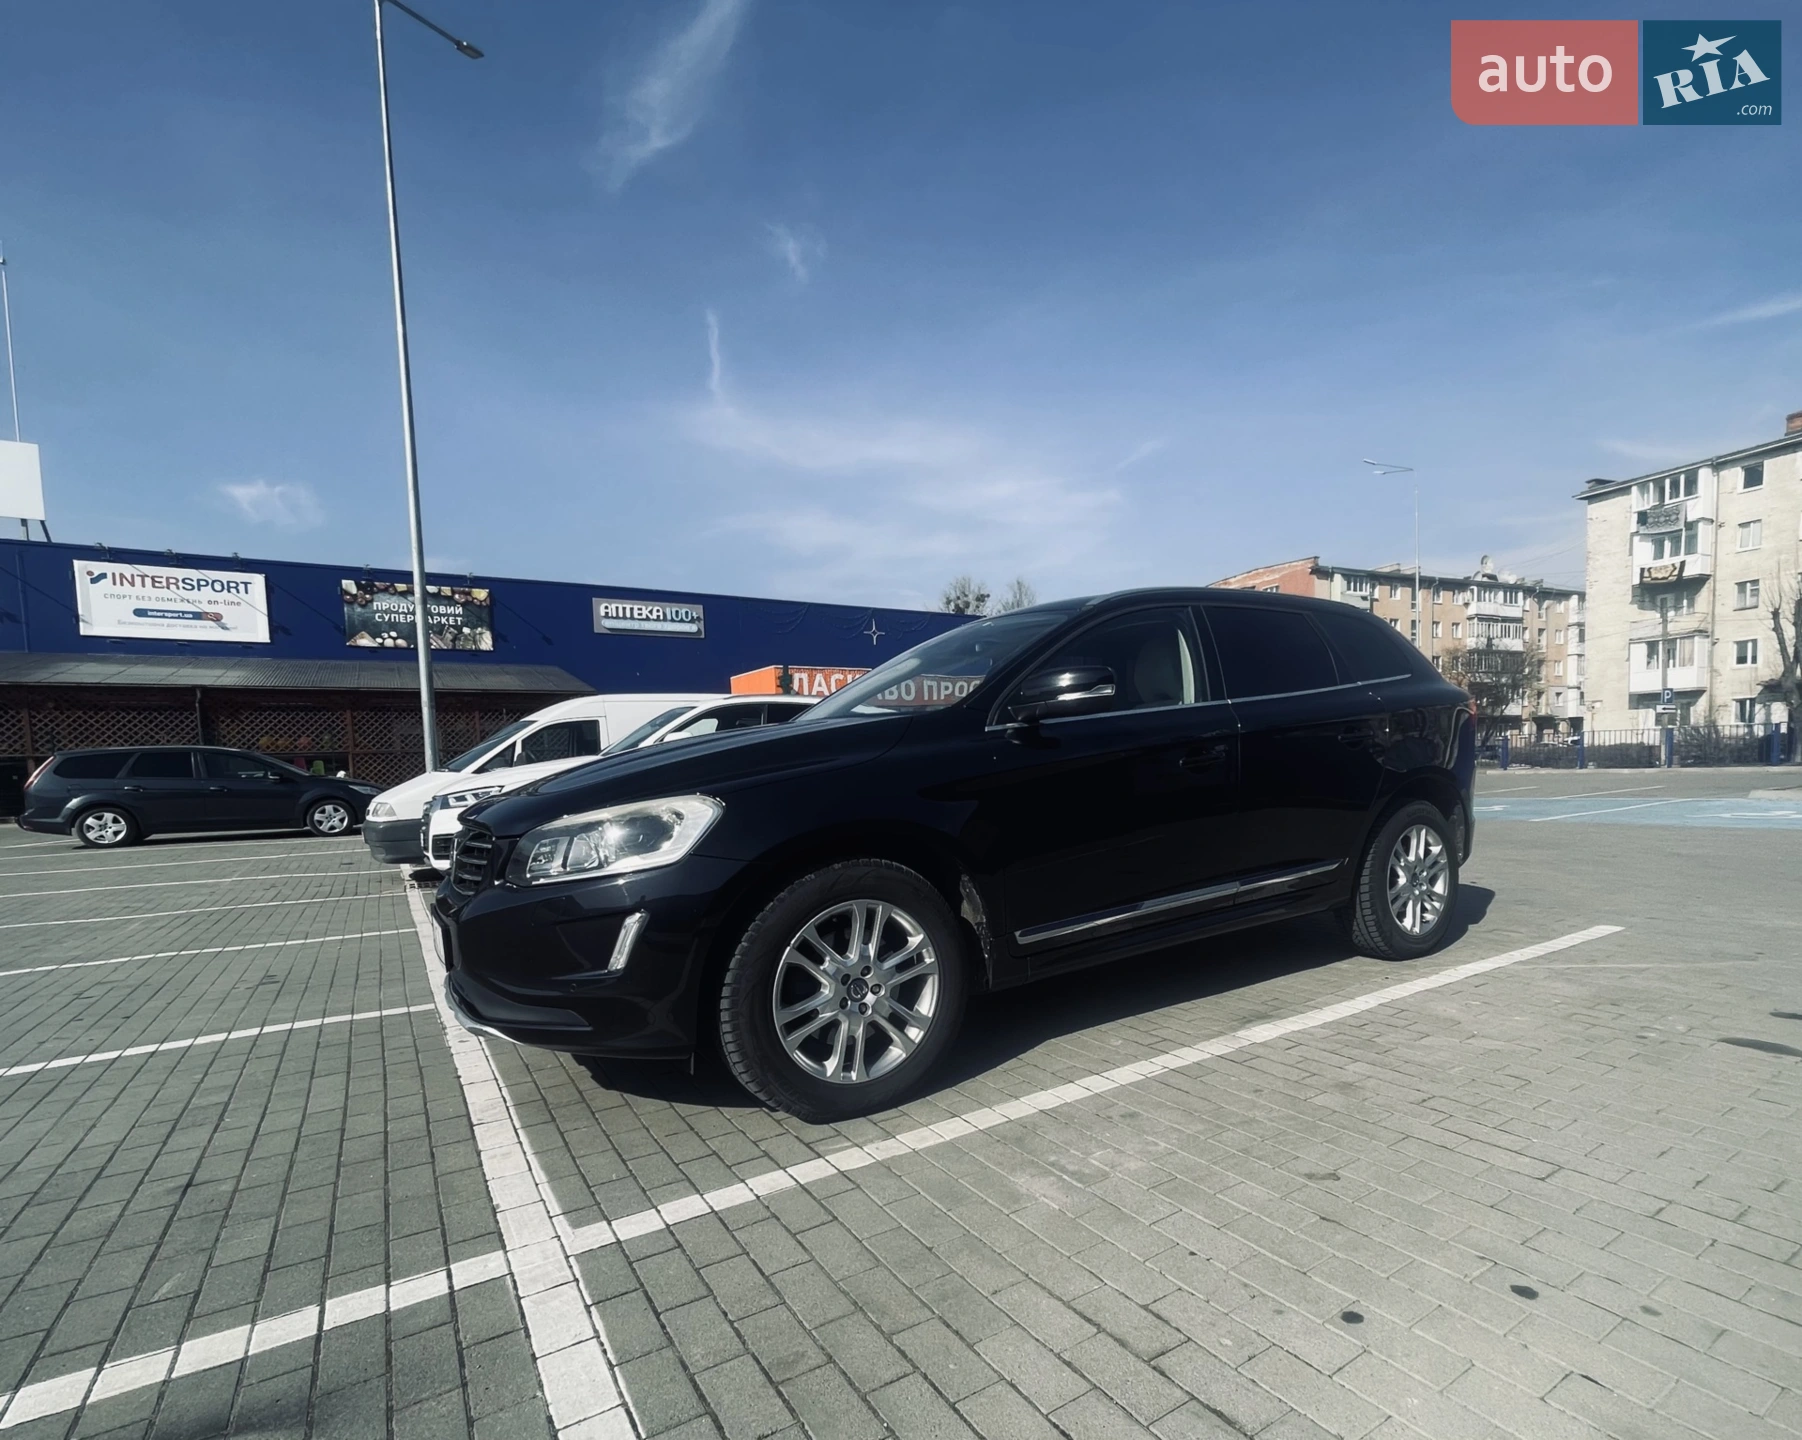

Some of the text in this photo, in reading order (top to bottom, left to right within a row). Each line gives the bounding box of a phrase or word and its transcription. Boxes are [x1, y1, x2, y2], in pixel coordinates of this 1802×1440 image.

[111, 571, 252, 595] INTERSPORT
[103, 593, 132, 601] СПОРТ
[207, 599, 242, 607] on-line
[147, 610, 193, 619] intersport.ua
[373, 601, 463, 615] ПРОДУОВИЙ
[600, 603, 699, 622] АПТЕКА 100+
[375, 612, 463, 625] СУПЕРАРКЕТ
[1664, 690, 1672, 703] P
